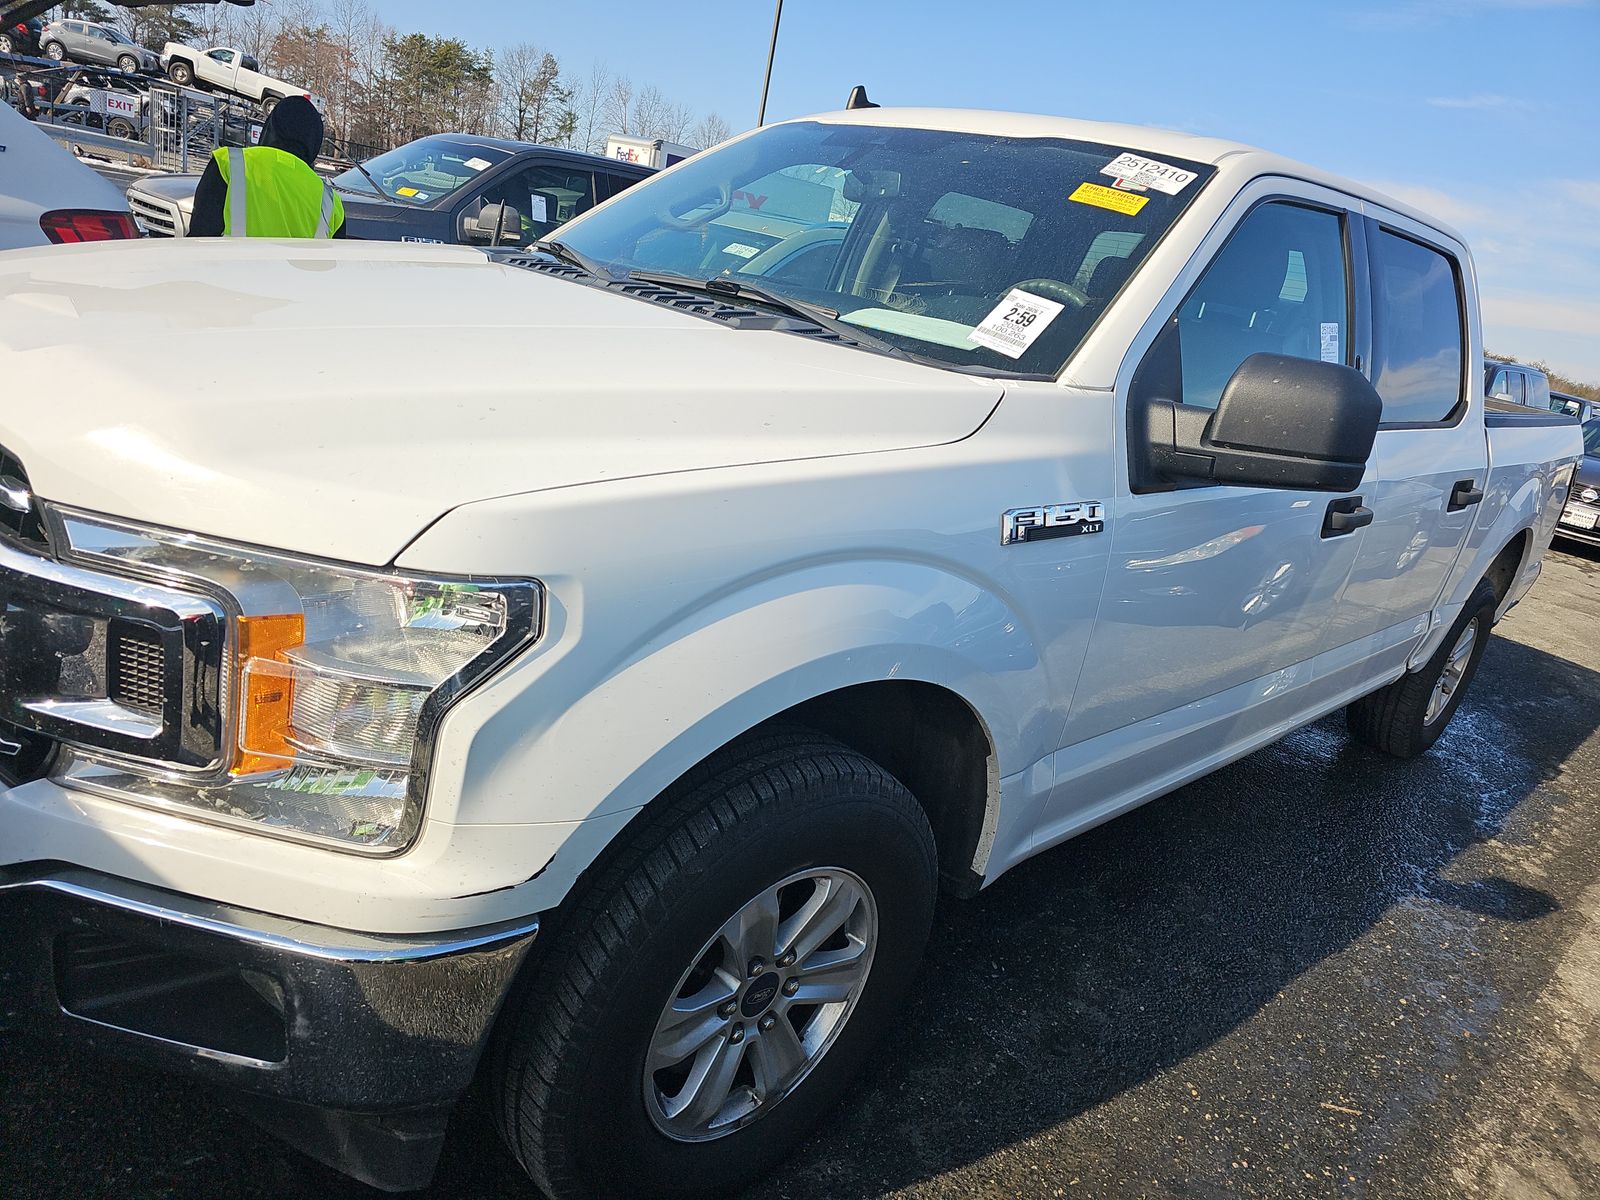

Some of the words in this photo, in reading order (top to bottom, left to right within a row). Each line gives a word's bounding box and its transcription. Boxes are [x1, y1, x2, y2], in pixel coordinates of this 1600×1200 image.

[108, 98, 134, 112] EXIT
[616, 146, 639, 162] FedEx
[1117, 156, 1189, 183] 2512410
[1085, 185, 1104, 193] THIS
[1107, 190, 1143, 202] VEHICLE
[1003, 307, 1037, 327] 2:59
[991, 324, 1027, 341] 100,263
[1001, 320, 1025, 333] 2020
[1081, 523, 1101, 534] XLT
